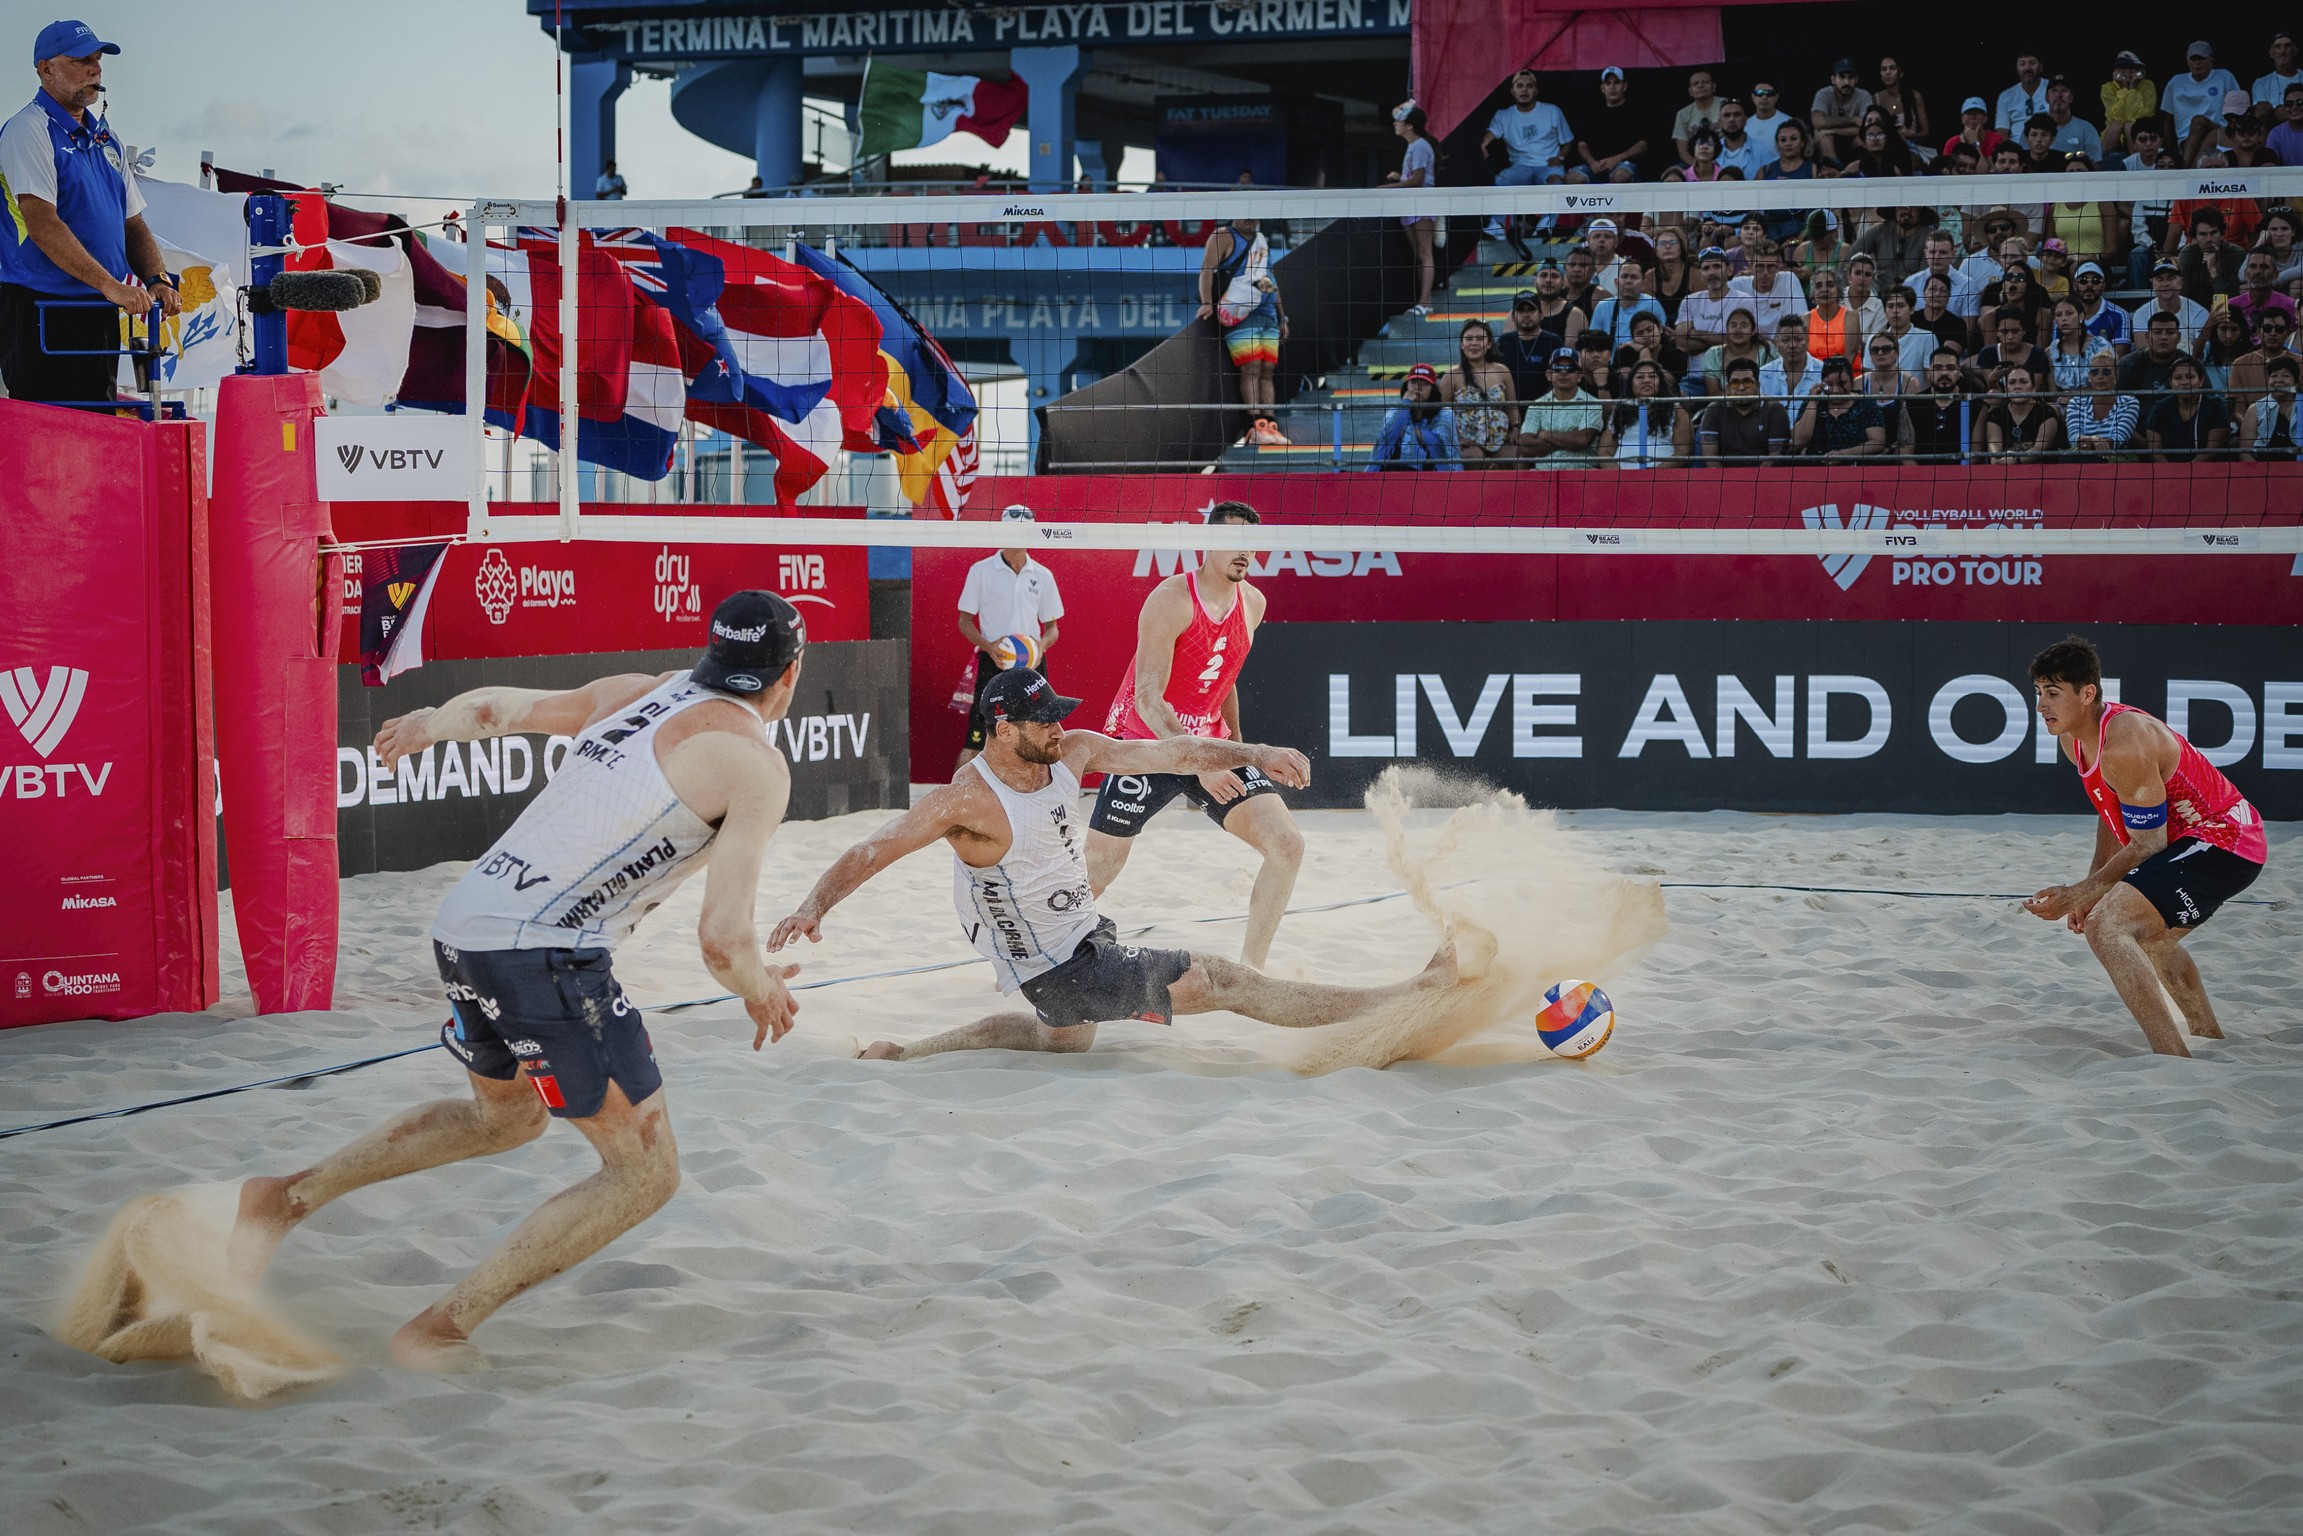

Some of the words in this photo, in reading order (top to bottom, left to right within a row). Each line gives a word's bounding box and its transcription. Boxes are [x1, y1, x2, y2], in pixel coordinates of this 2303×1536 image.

[622, 15, 792, 53] TERMINAL
[802, 9, 975, 48] MARITIMA
[995, 5, 1111, 42] PLAYA
[1127, 1, 1195, 37] DEL
[1167, 106, 1197, 121] FAT
[1200, 104, 1273, 120] TUESDAY
[1580, 197, 1614, 207] VBTV
[982, 297, 1102, 328] PLAYA
[1118, 295, 1182, 328] DEL
[369, 449, 445, 470] VBTV
[1894, 509, 1986, 521] VOLLEYBALL
[1988, 509, 2044, 520] WORLD
[1884, 536, 1917, 546] FIVB
[655, 544, 690, 593] dry
[779, 554, 825, 590] FIVB
[1892, 561, 1956, 586] PRO
[1960, 561, 2044, 586] TOUR
[520, 565, 576, 608] Playa
[654, 585, 679, 623] up
[712, 620, 761, 642] Herbalife
[1198, 654, 1224, 680] 2
[1329, 673, 1583, 758] LIVE
[1617, 673, 1892, 760] AND
[601, 715, 651, 745] 2
[783, 712, 871, 764] VBTV
[337, 734, 534, 808] DEMAND
[1111, 800, 1146, 814] cooltra
[622, 836, 678, 881] PLAYA
[42, 970, 120, 992] QUINTANA
[64, 984, 93, 996] ROO
[1577, 1036, 1596, 1051] FIVB
